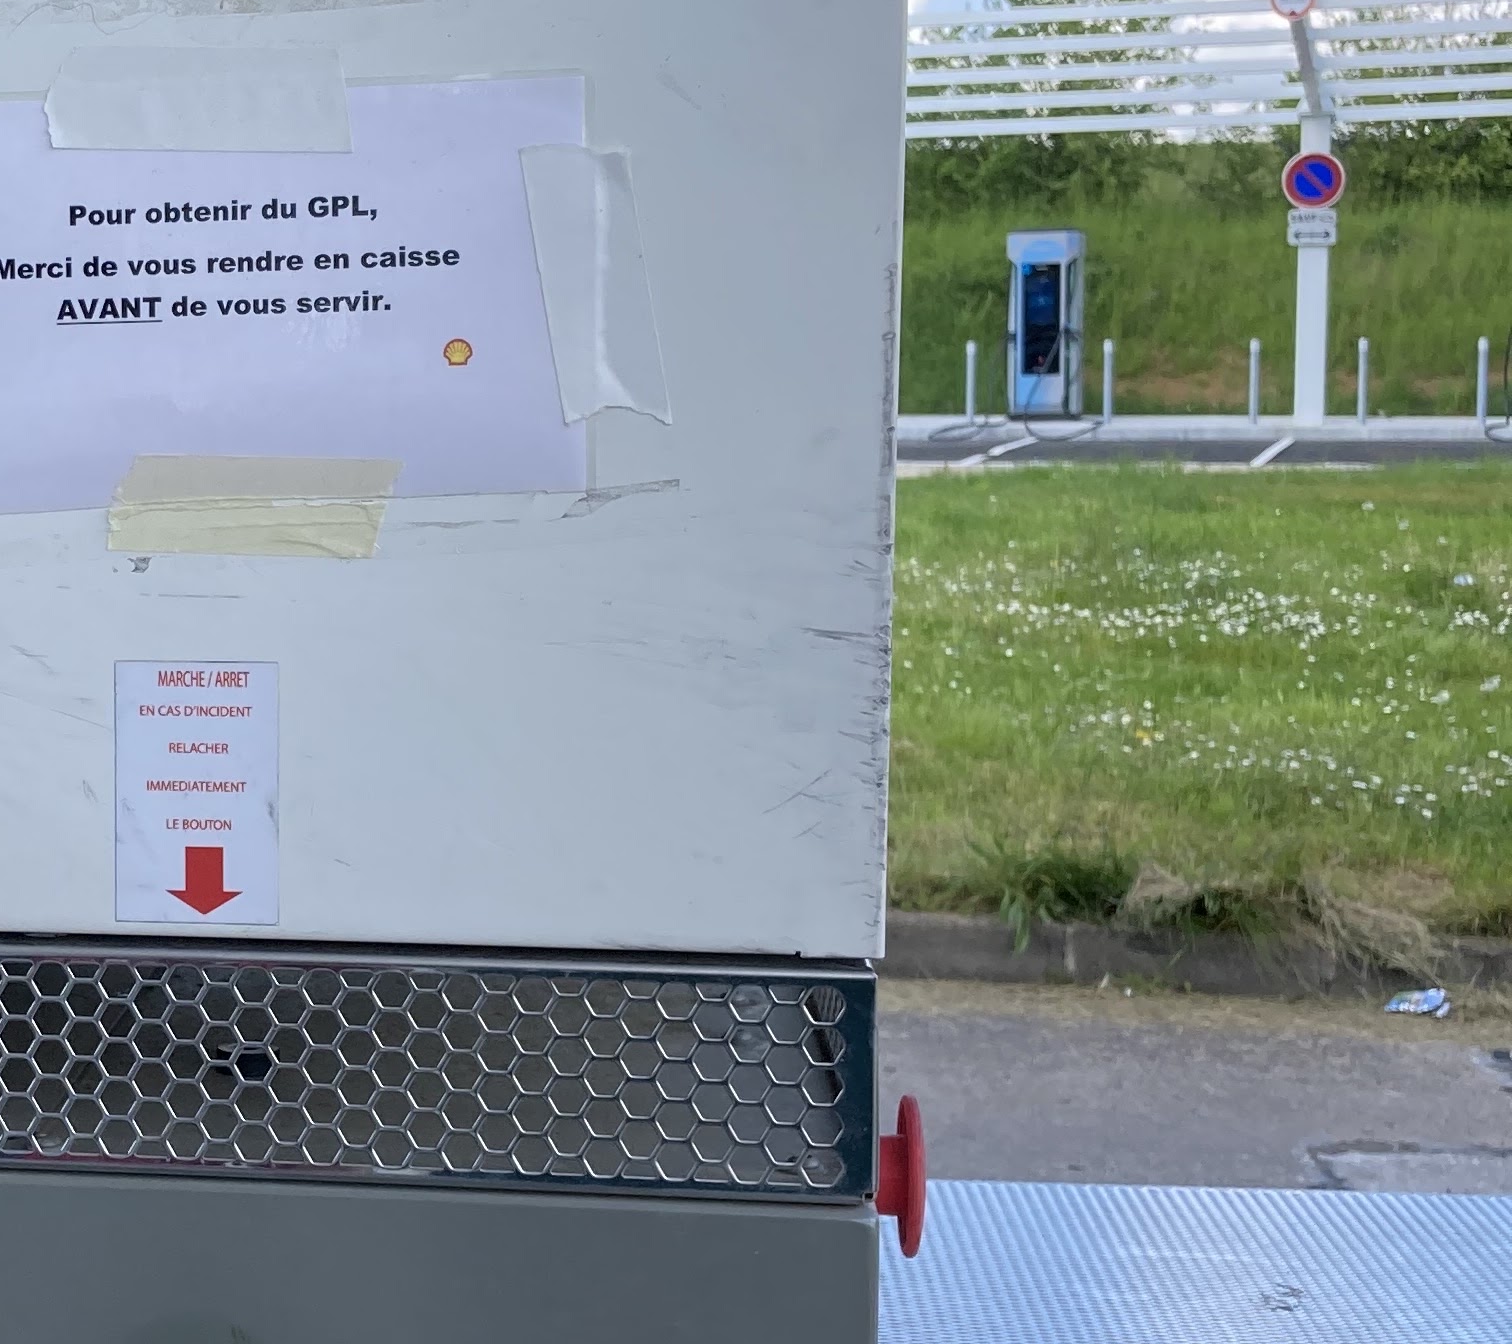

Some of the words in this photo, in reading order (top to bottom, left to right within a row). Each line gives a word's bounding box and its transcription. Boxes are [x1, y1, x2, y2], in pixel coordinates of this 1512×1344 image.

[70, 204, 136, 227] Pour
[145, 200, 251, 224] obtenir
[261, 199, 298, 220] du
[308, 196, 378, 222] GPL,
[82, 257, 118, 278] de
[128, 256, 196, 276] vous
[207, 251, 303, 274] rendre
[314, 252, 350, 271] en
[361, 246, 460, 268] caisse
[57, 296, 162, 323] AVANT
[172, 295, 207, 318] de
[217, 295, 286, 315] vous
[296, 290, 392, 313] servir.
[158, 670, 205, 688] MARCHE
[207, 671, 213, 688] /
[215, 671, 249, 688] ARRET
[139, 705, 156, 716] EN
[158, 706, 181, 717] CAS
[184, 706, 252, 717] D'INCIDENT
[168, 742, 229, 754] RELACHER
[146, 780, 247, 792] IMMEDIATEMENT
[166, 819, 180, 830] LE
[182, 819, 232, 831] BOUTON
